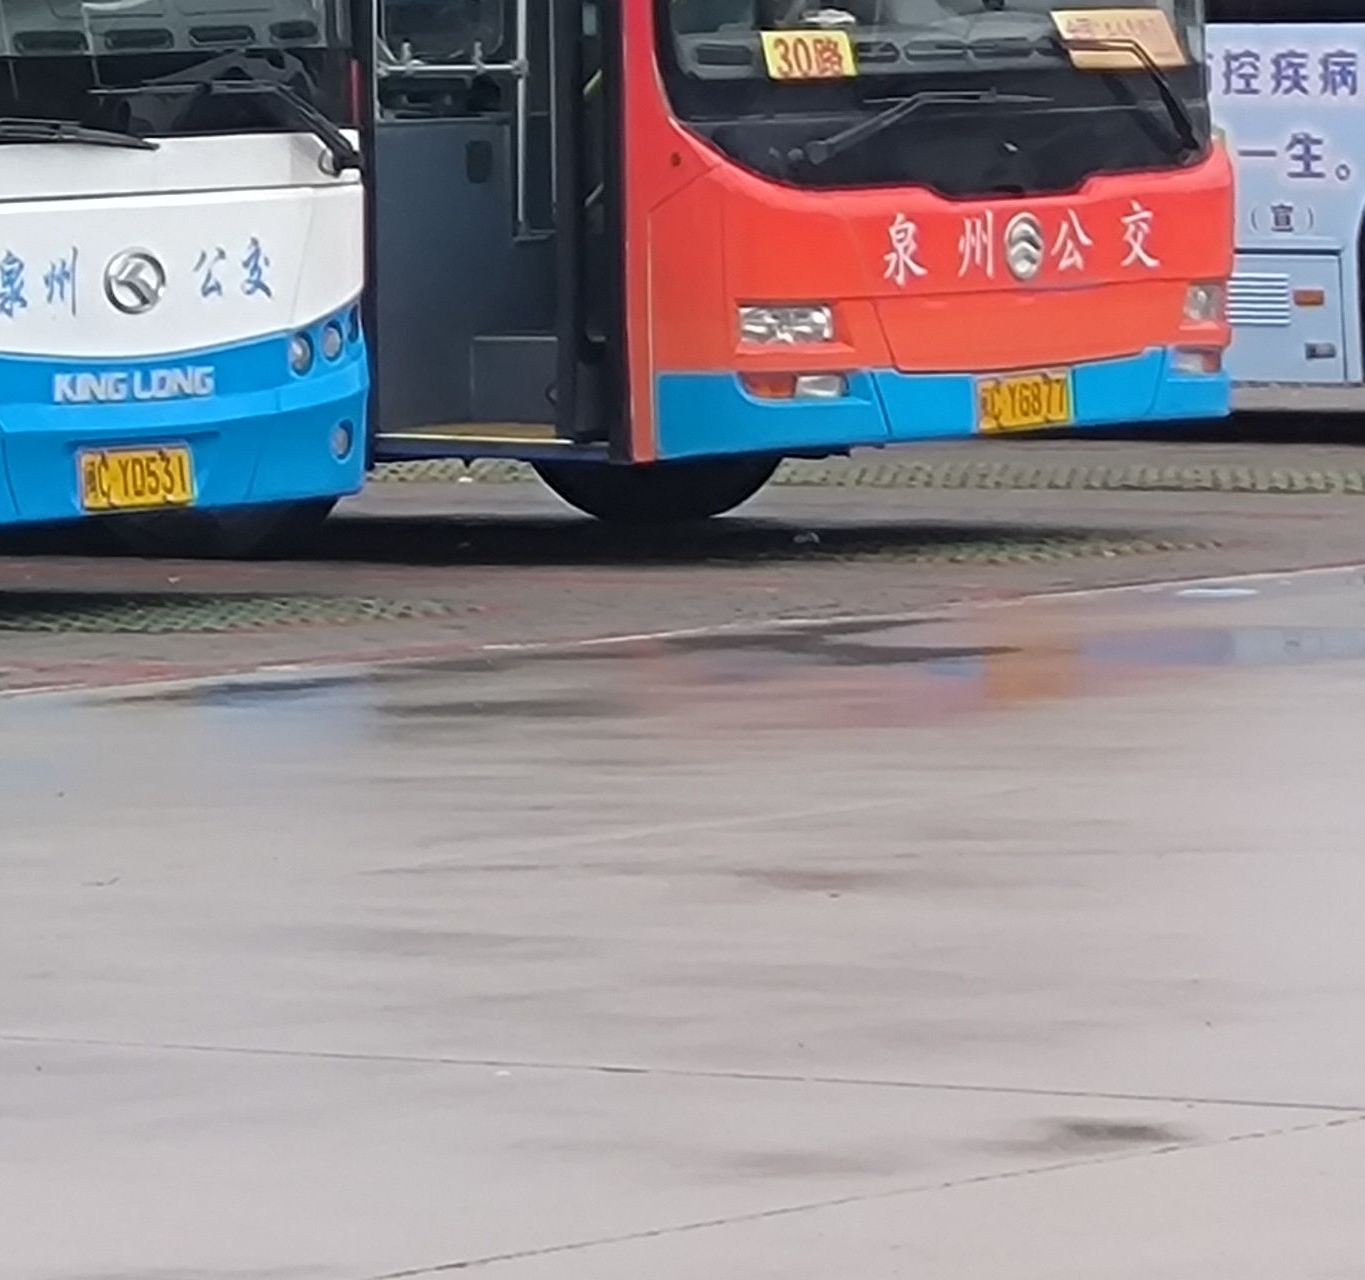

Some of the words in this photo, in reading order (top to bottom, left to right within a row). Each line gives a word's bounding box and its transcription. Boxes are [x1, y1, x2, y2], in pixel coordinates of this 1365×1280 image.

[773, 36, 844, 77] 30路
[1207, 49, 1357, 97] 控疾病
[882, 210, 995, 287] 泉州
[1051, 199, 1161, 271] 公交
[192, 236, 273, 299] 公交
[53, 372, 126, 404] KING
[132, 366, 214, 400] LONG
